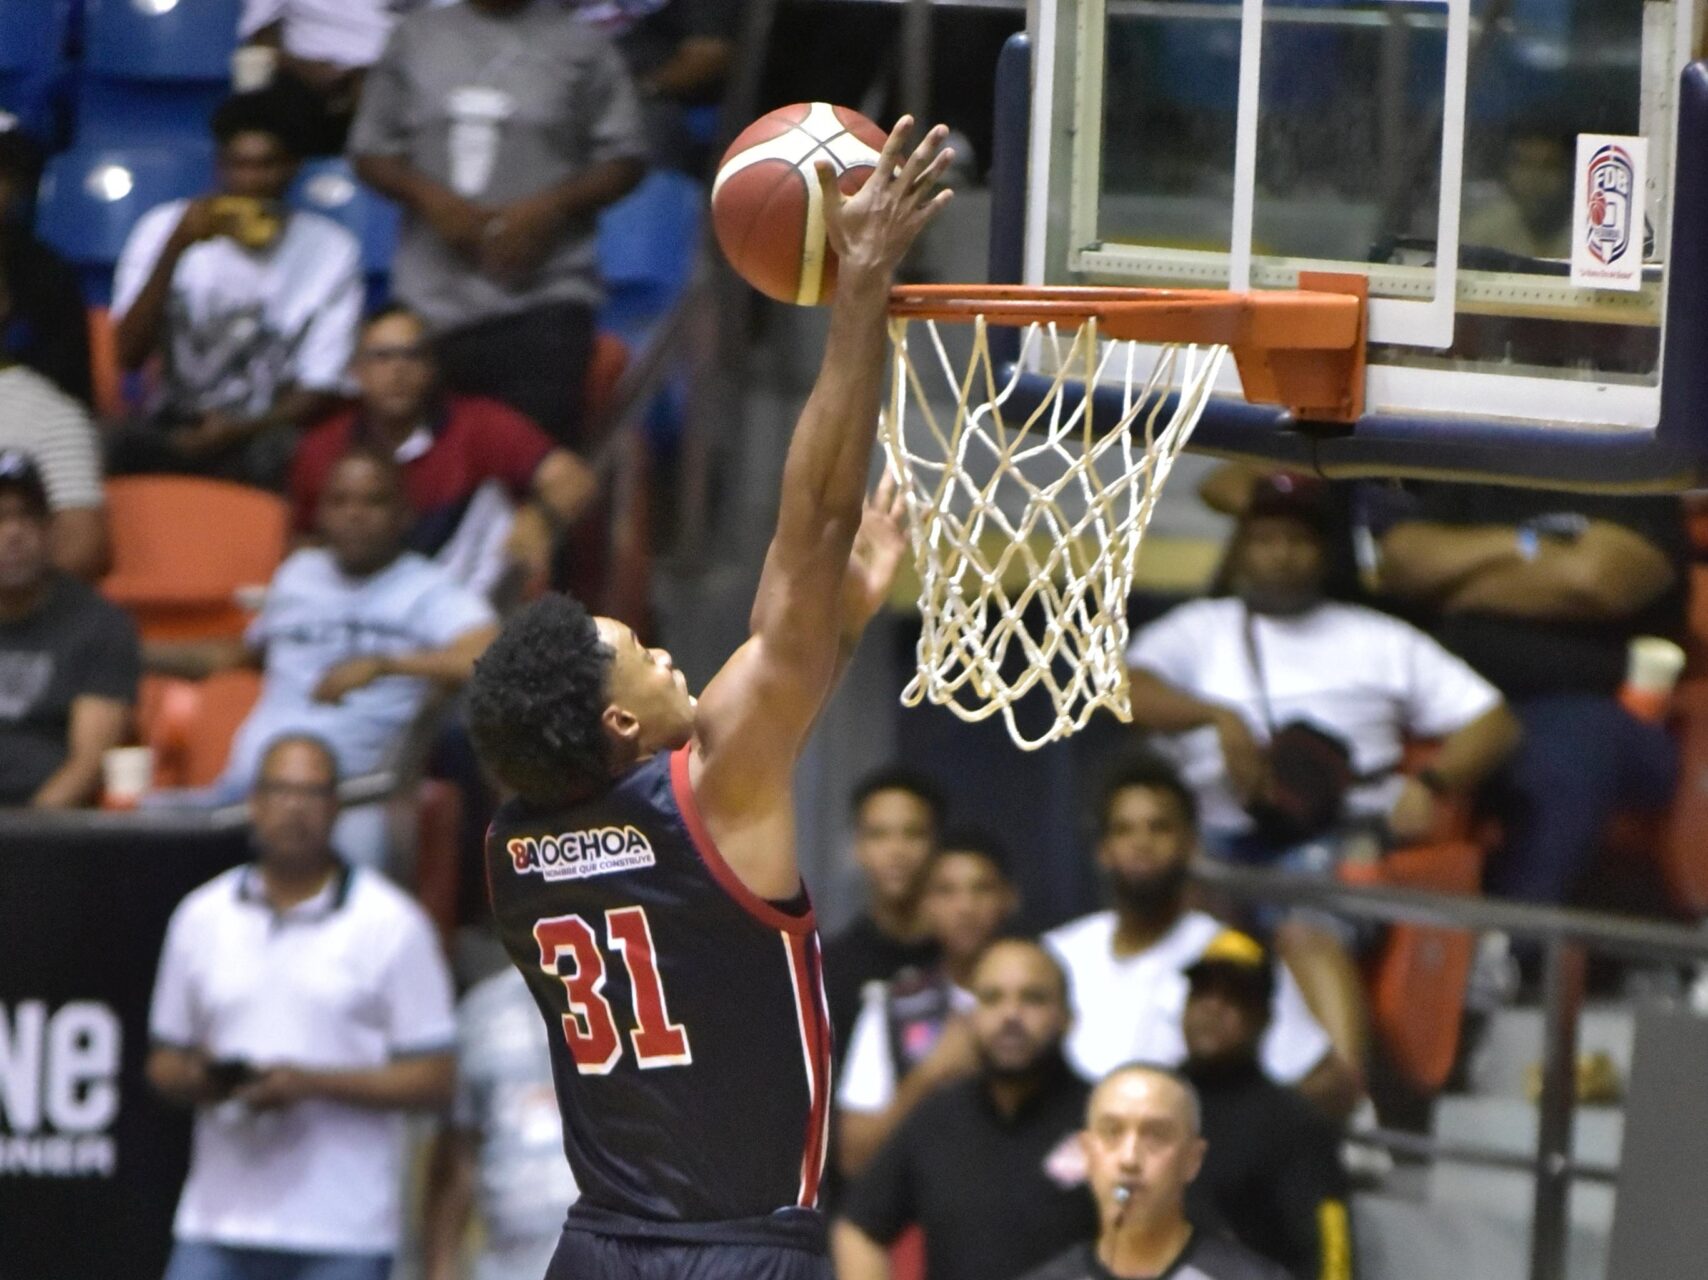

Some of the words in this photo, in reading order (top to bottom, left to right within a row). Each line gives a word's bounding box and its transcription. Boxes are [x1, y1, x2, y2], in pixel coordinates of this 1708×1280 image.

[510, 841, 541, 869] 8A
[541, 830, 648, 866] OCHOA
[579, 863, 598, 874] QUE
[599, 854, 651, 870] CONSTRUYE
[533, 905, 692, 1075] 31
